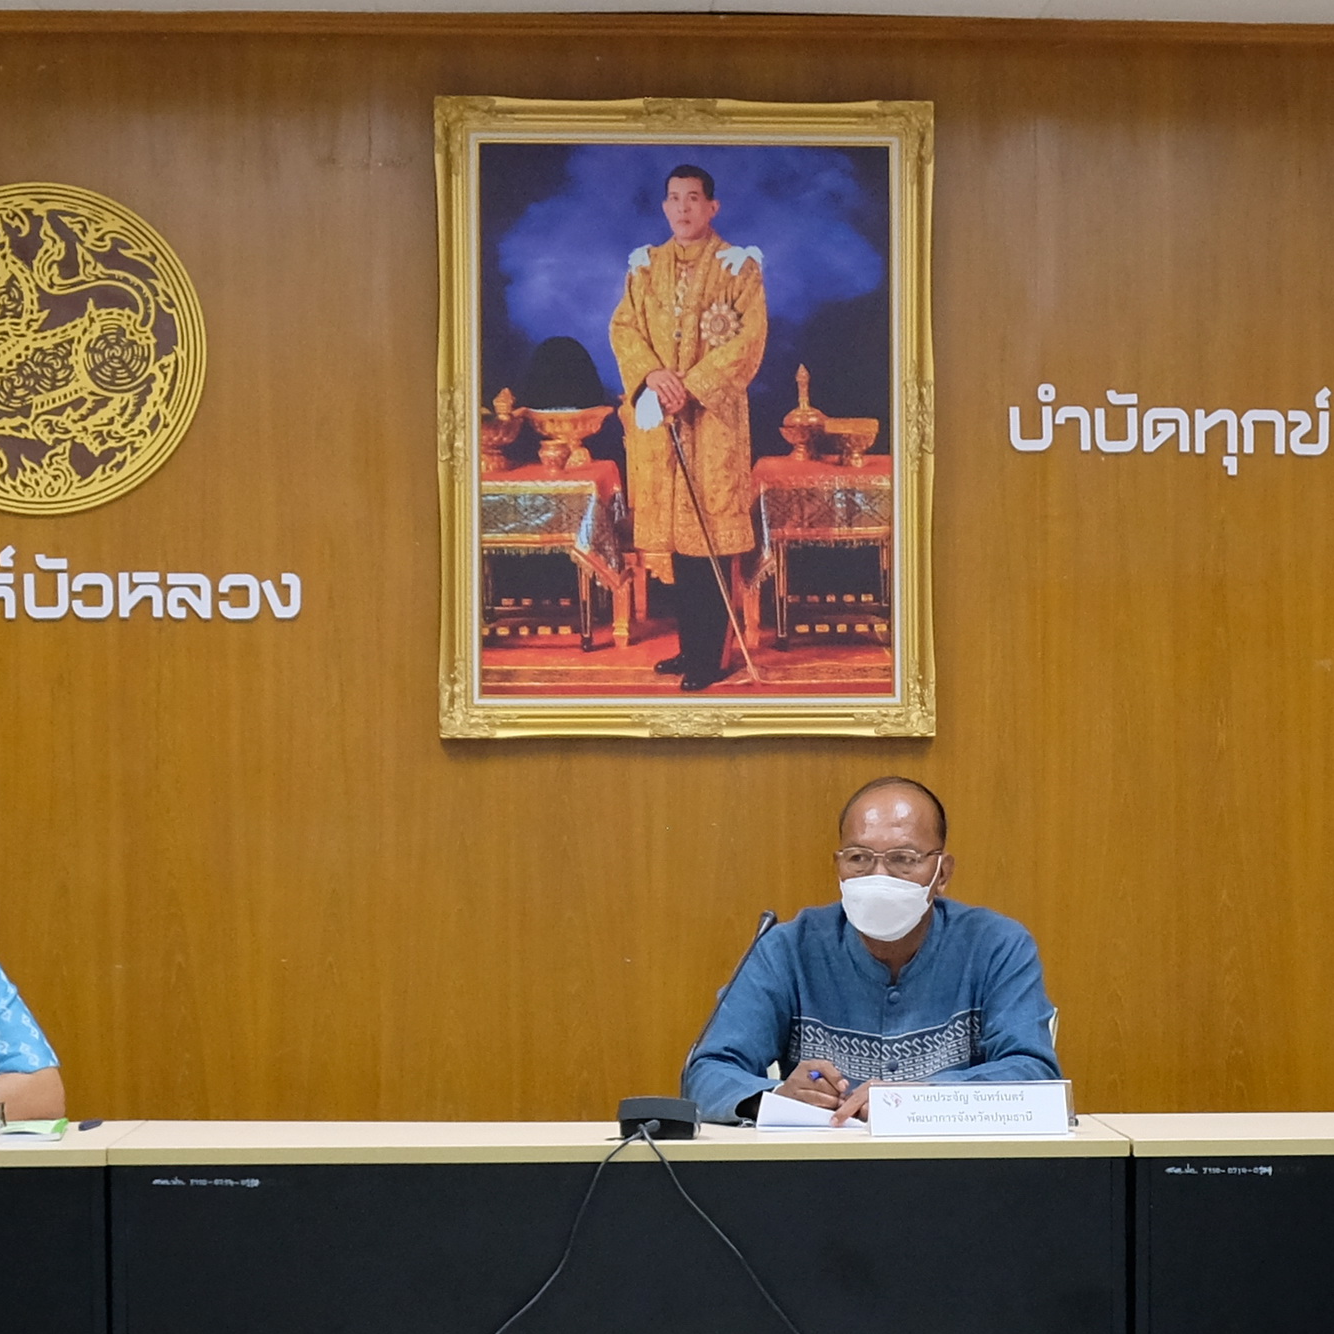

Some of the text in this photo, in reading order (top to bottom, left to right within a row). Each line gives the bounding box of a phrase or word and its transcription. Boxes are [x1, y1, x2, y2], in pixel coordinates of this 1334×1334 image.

[1009, 383, 1331, 476] บำบัดทุกข์
[906, 1110, 1033, 1125] พัฒนาการจังหวัดปทุมธานี
